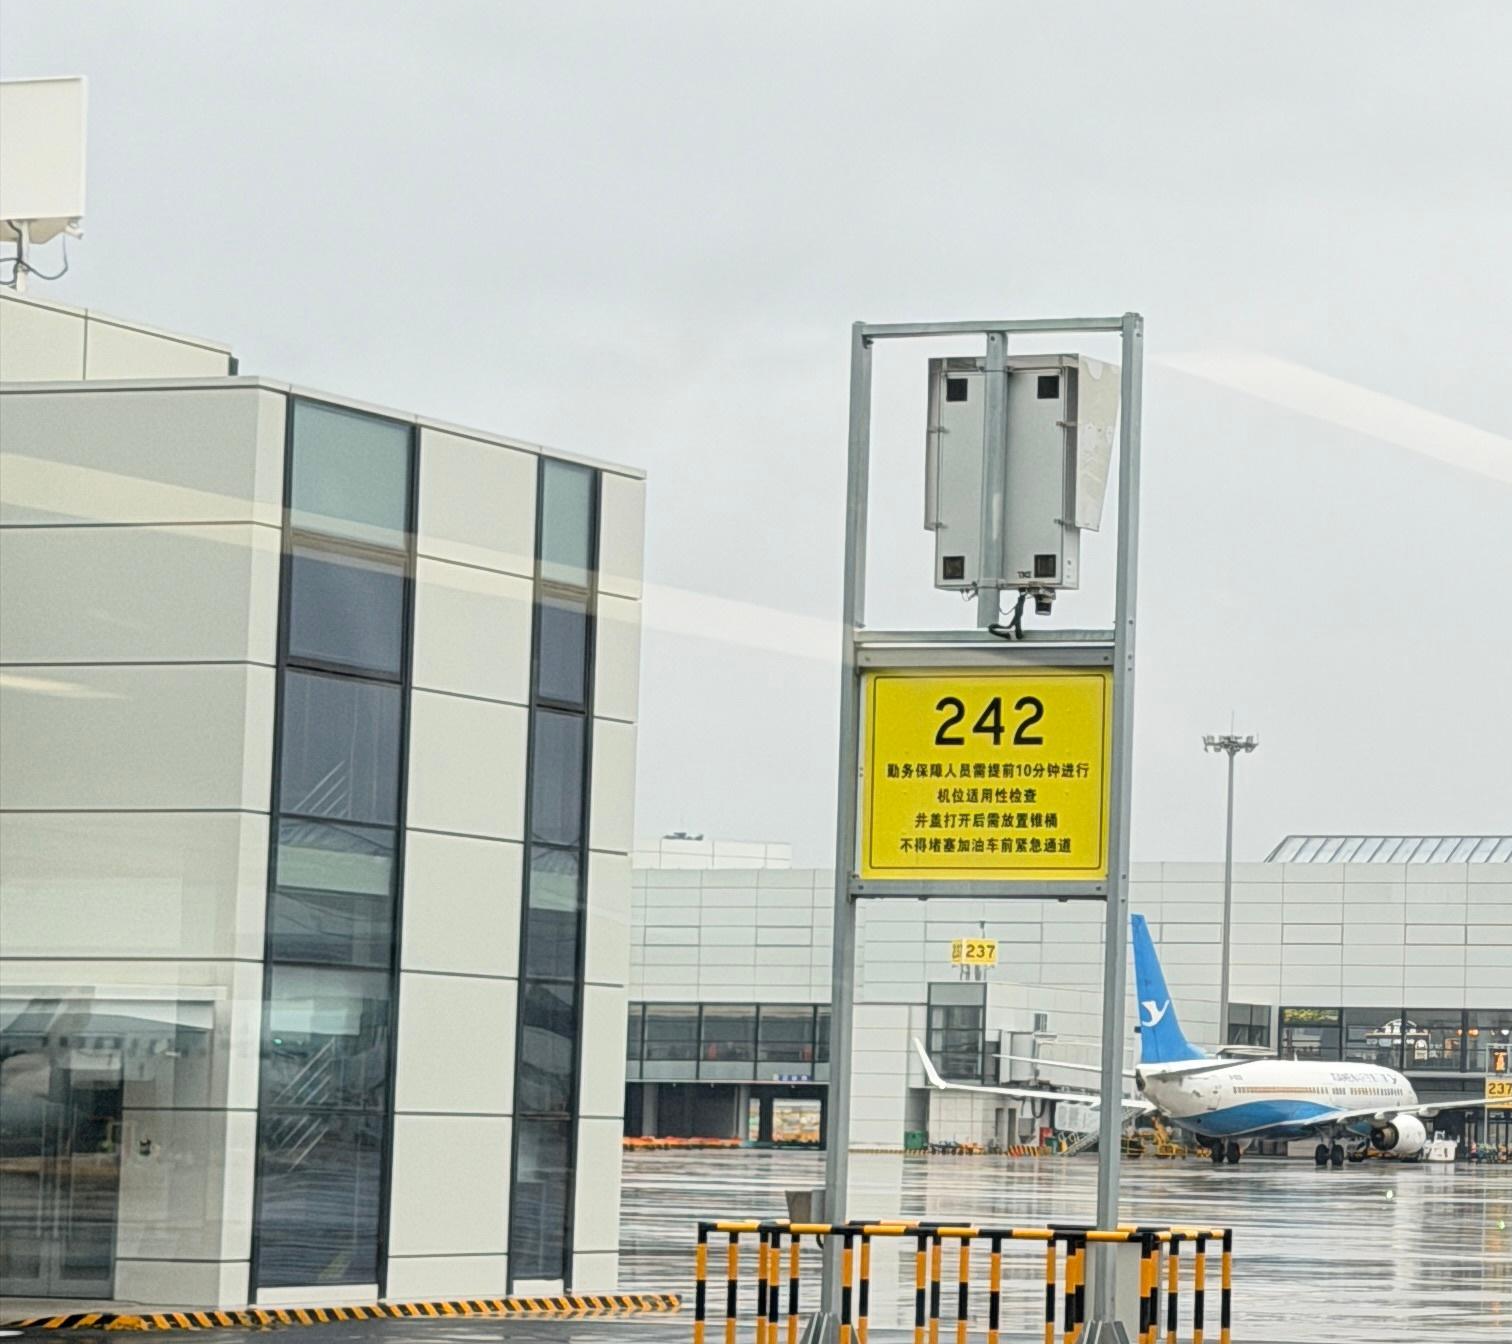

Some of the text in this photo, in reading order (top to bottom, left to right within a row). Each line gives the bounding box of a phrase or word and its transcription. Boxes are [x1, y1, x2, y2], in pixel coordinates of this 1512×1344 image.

[935, 696, 1044, 745] 242
[887, 763, 1089, 778] 勤务保障人员需提前10分钟进行
[937, 788, 1036, 803] 机位适用性检查
[915, 812, 1058, 829] 井盖打开后需放置锥桶
[900, 838, 1072, 853] 不得堵塞加油车前紧急通道
[966, 944, 996, 958] 237
